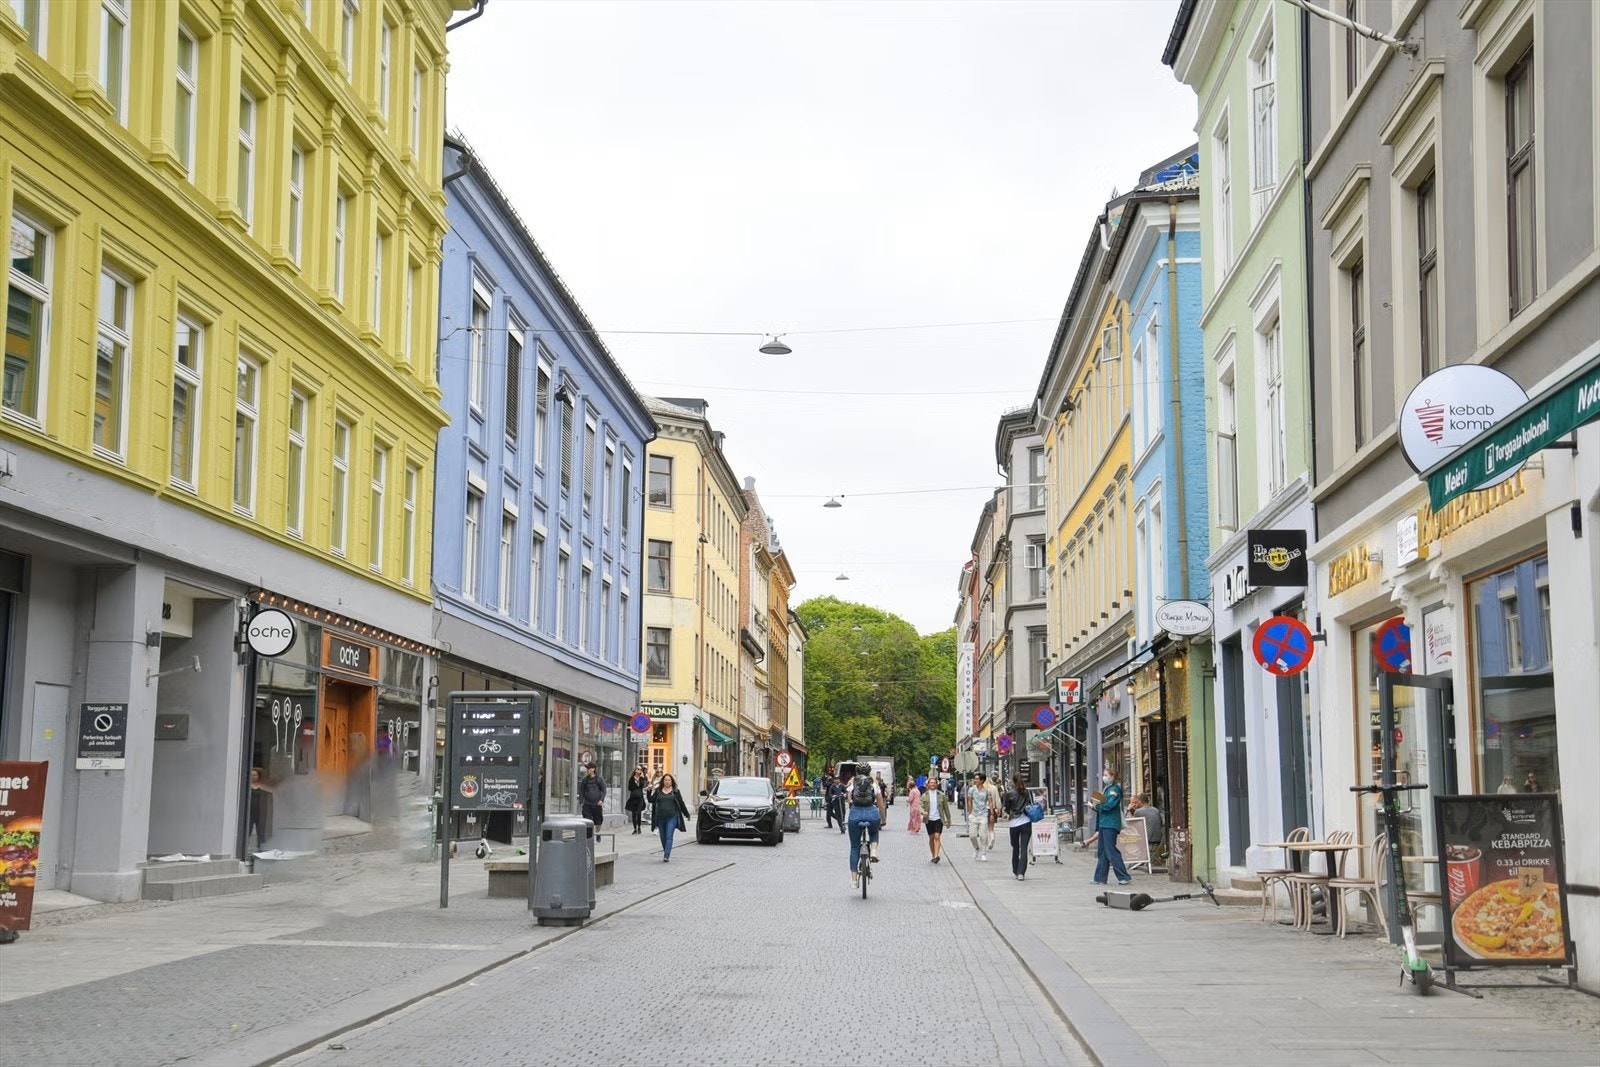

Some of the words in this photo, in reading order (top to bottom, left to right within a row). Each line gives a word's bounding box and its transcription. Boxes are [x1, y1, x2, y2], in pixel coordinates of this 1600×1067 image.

[1450, 405, 1495, 416] kebab
[1450, 420, 1497, 433] komp
[1495, 435, 1522, 462] Torggata
[1522, 412, 1549, 446] kolonial
[1254, 548, 1304, 563] Martens
[250, 626, 291, 638] oche
[339, 645, 359, 667] oche
[1061, 680, 1078, 706] 7
[0, 776, 29, 790] met
[1491, 841, 1551, 849] KEBABPIZZA
[1522, 859, 1550, 867] DRIKKE
[1508, 868, 1518, 876] til
